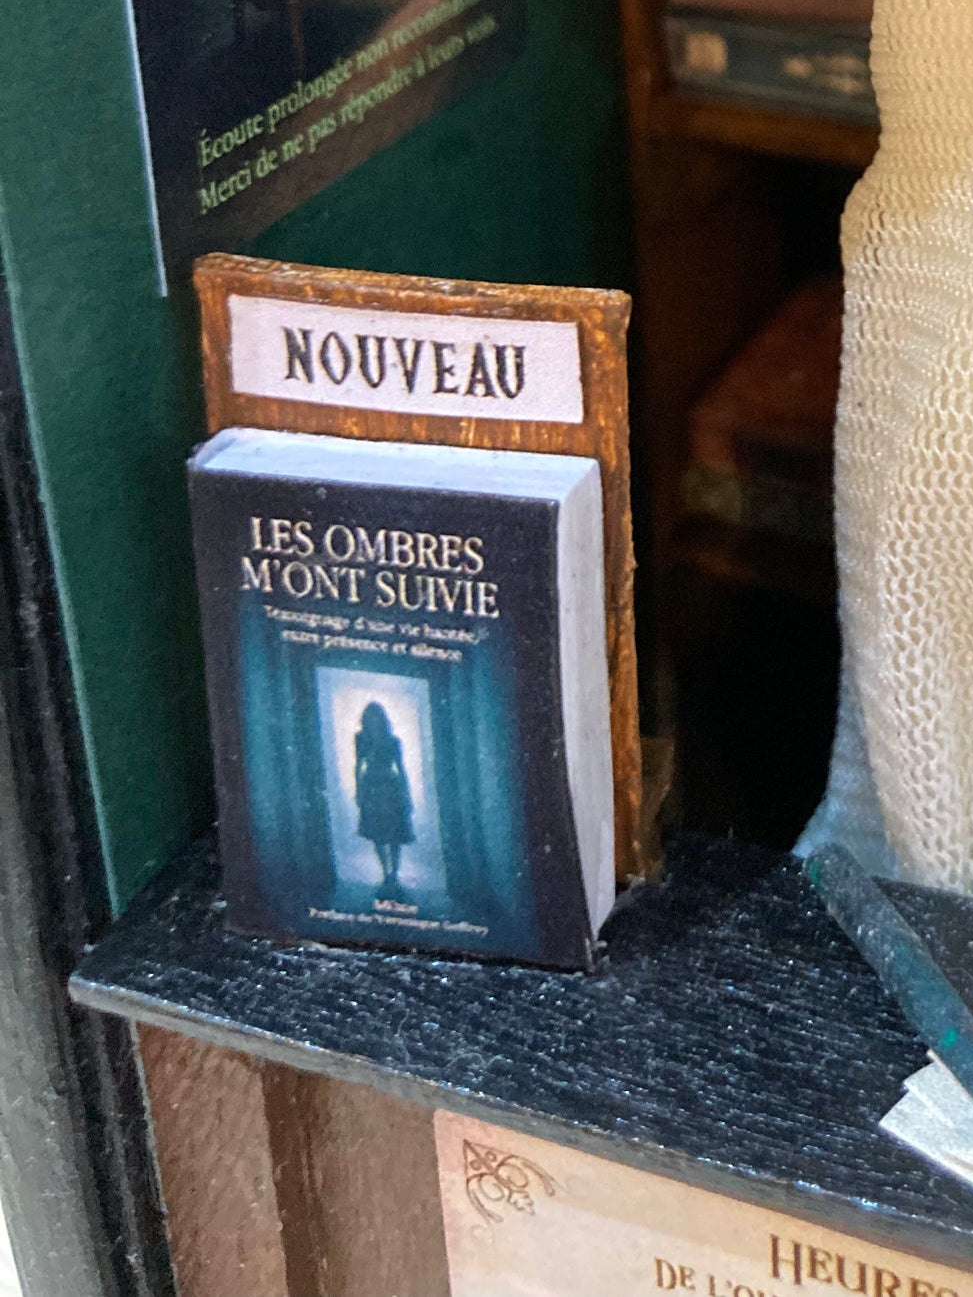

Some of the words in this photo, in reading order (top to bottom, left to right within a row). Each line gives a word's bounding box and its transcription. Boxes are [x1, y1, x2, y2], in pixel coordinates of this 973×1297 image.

[199, 113, 264, 168] Écoute
[199, 161, 252, 215] Merci
[255, 146, 279, 178] de
[307, 114, 337, 153] pas
[282, 325, 527, 400] NOUVEAU
[251, 516, 315, 558] LES
[324, 523, 485, 576] OMBRES
[240, 556, 366, 604] M'ONT
[375, 570, 500, 620] SUIVIE
[654, 1256, 696, 1291] DE
[707, 1274, 778, 1297] L'O
[768, 1233, 960, 1297] HEURE
